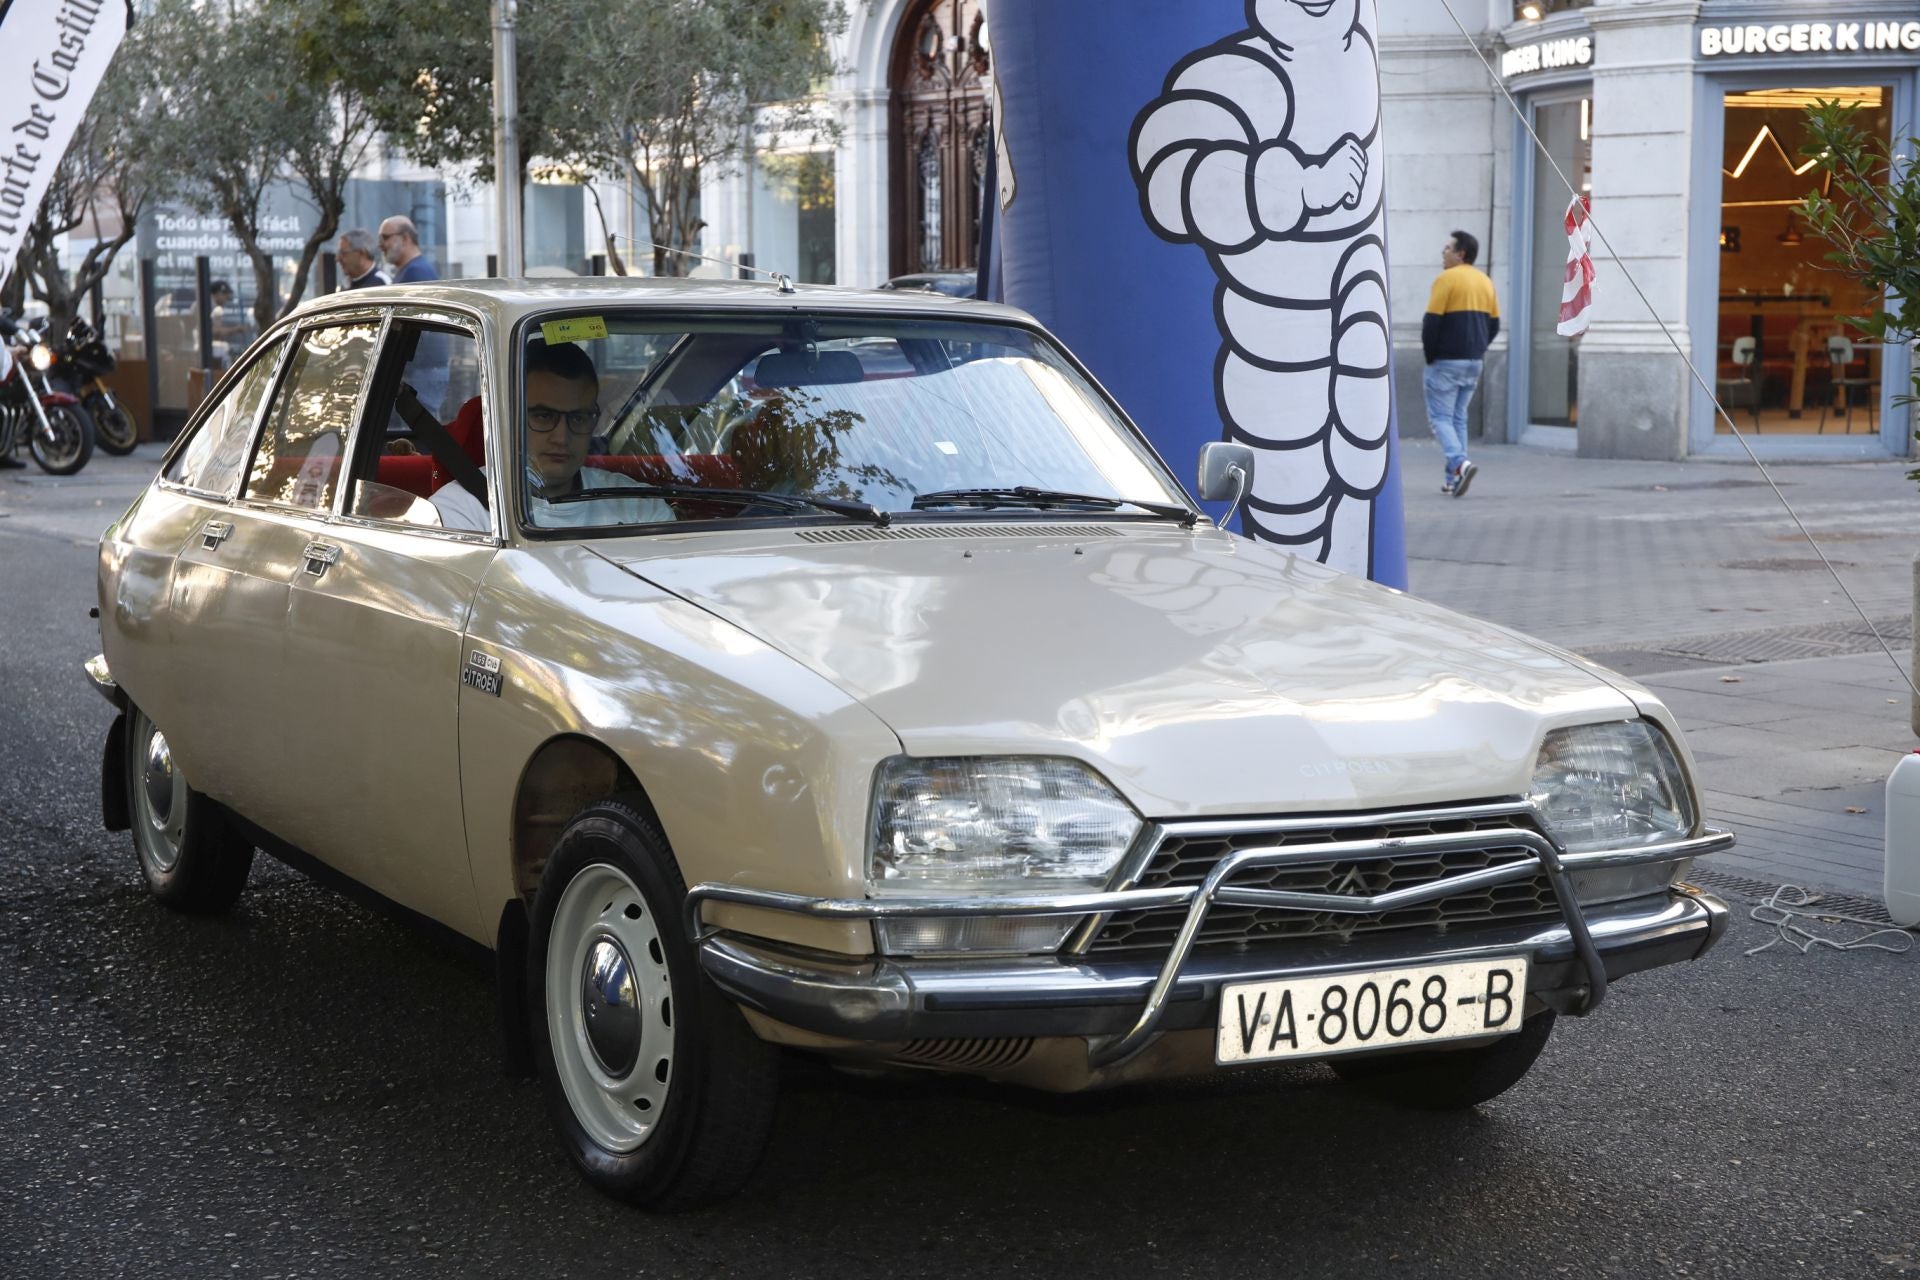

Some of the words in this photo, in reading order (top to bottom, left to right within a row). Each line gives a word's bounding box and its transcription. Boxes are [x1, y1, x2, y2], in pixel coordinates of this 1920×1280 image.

[31, 0, 104, 101] Castil
[1541, 36, 1591, 68] KING
[1701, 23, 1832, 55] BURGER
[1836, 22, 1920, 50] KING
[11, 103, 56, 140] de
[155, 214, 197, 231] Todo
[263, 215, 301, 231] fácil
[156, 234, 220, 250] cuando
[157, 251, 174, 267] el
[177, 251, 234, 268] mimo
